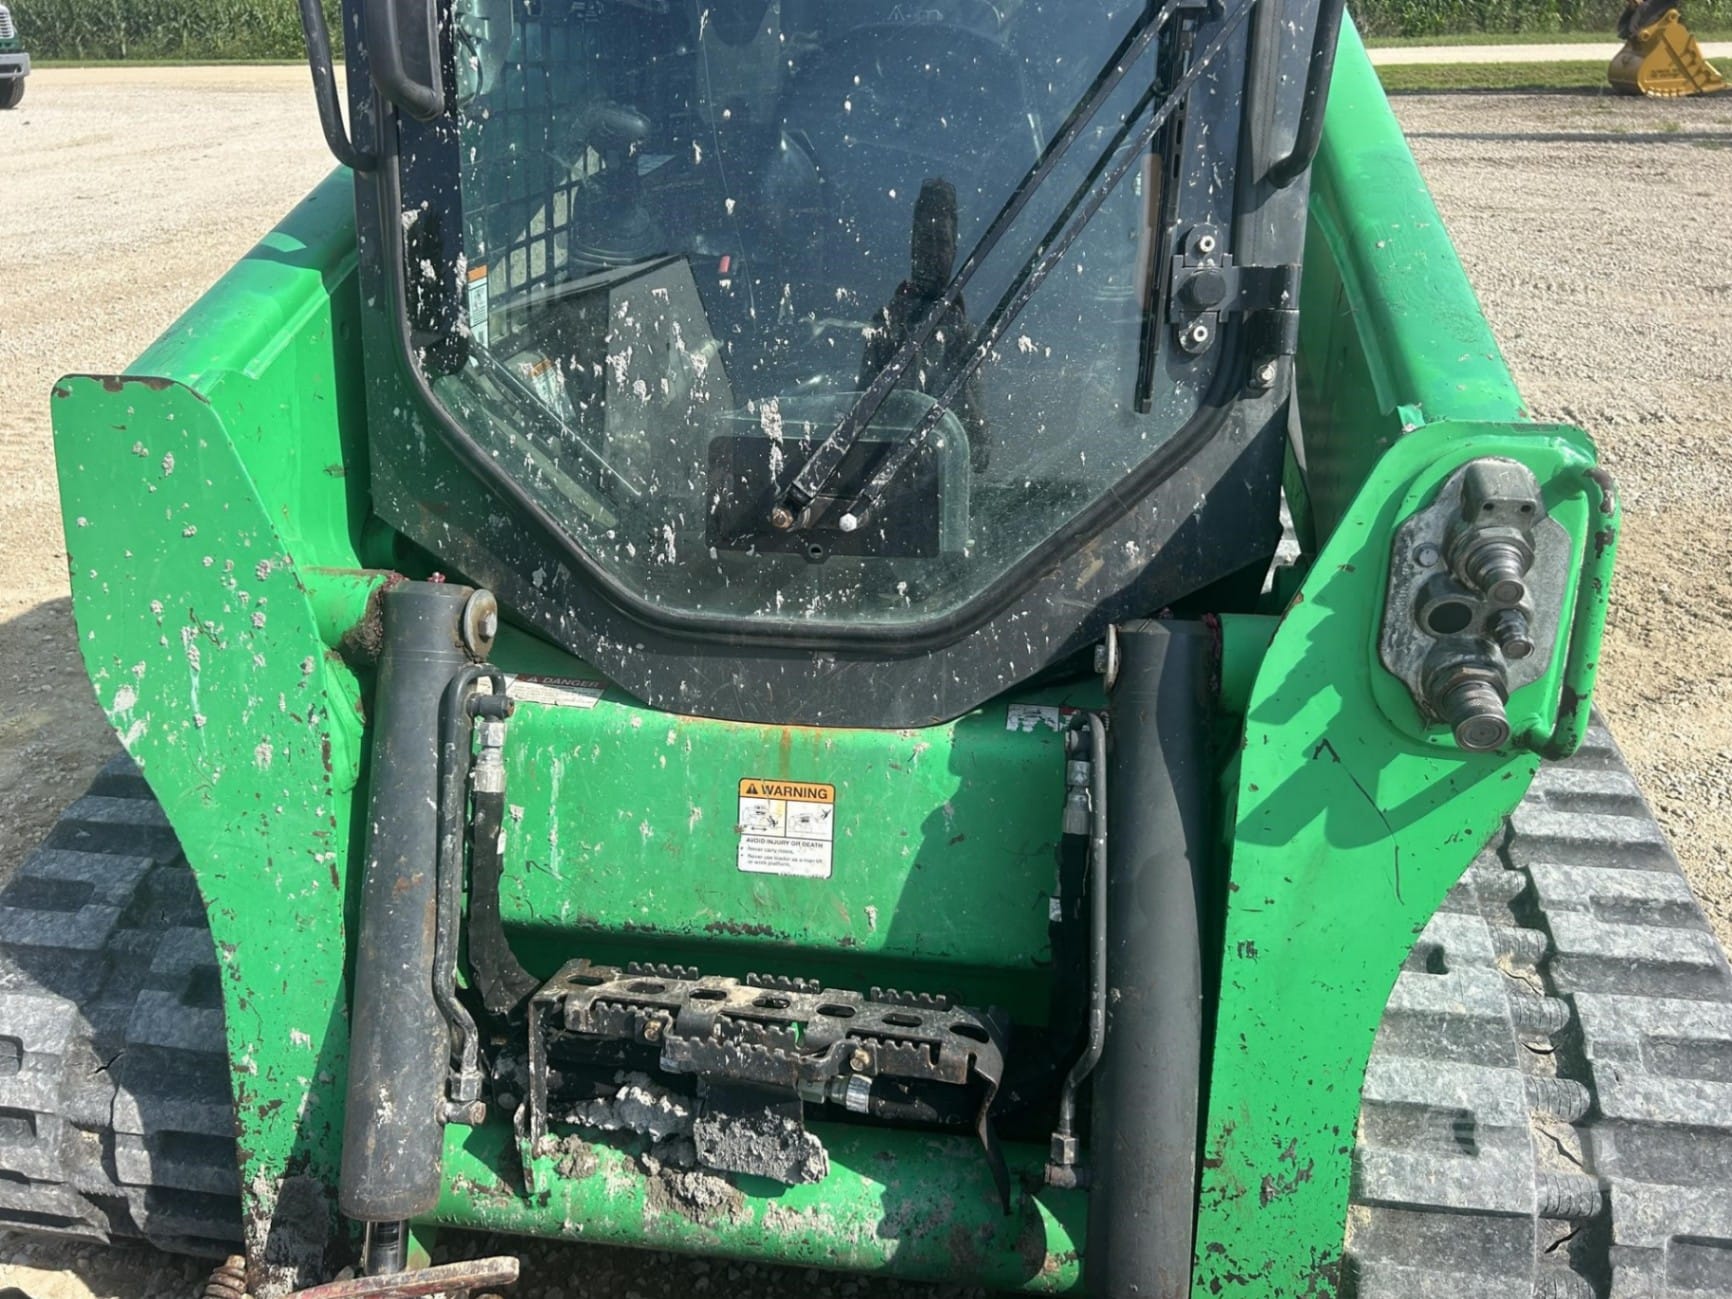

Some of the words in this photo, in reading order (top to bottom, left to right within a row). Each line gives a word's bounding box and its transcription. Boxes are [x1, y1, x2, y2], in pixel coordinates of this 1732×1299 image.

[542, 677, 600, 688] DANGER
[761, 784, 828, 800] WARNING
[746, 837, 766, 845] AVOID
